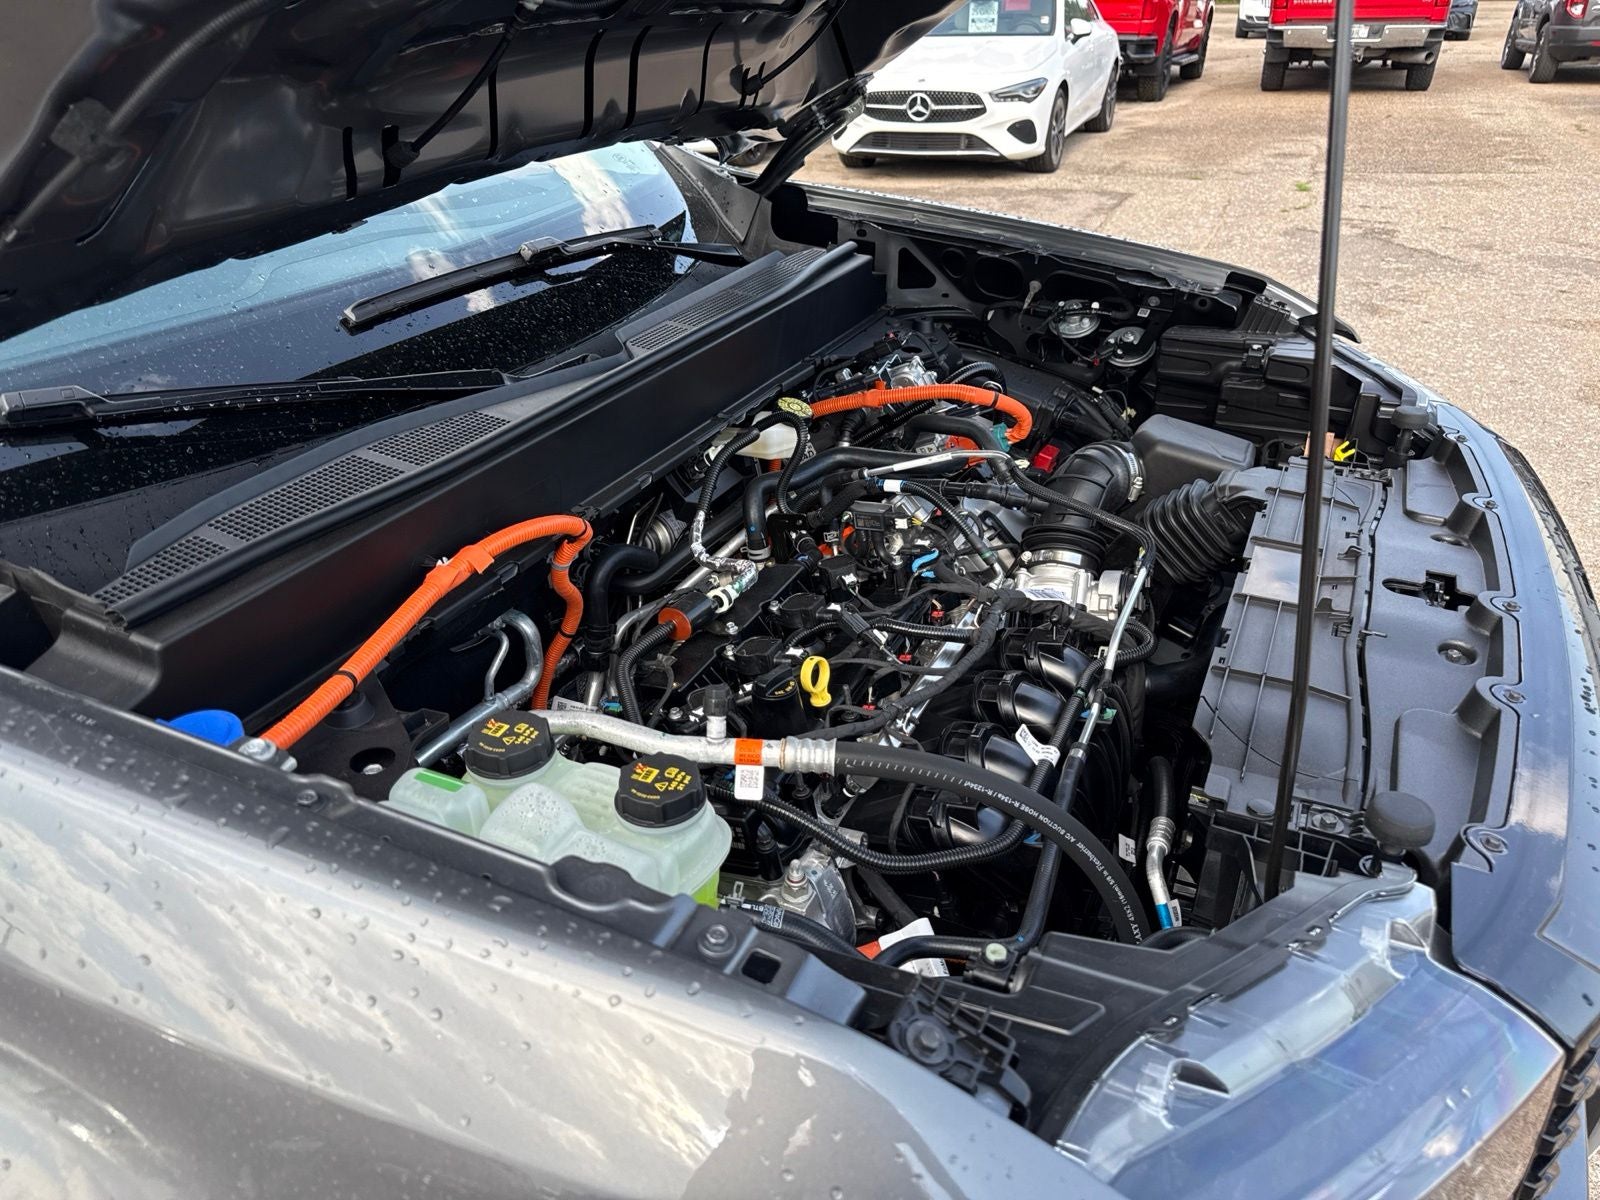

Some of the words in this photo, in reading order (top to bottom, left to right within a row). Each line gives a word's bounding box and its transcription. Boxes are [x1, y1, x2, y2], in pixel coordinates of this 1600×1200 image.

[997, 793, 1021, 808] R-134a
[1019, 803, 1040, 817] HOSE
[1038, 814, 1067, 836] SUCTION
[1064, 833, 1077, 843] A/C
[1076, 841, 1105, 872] Flexbarrier
